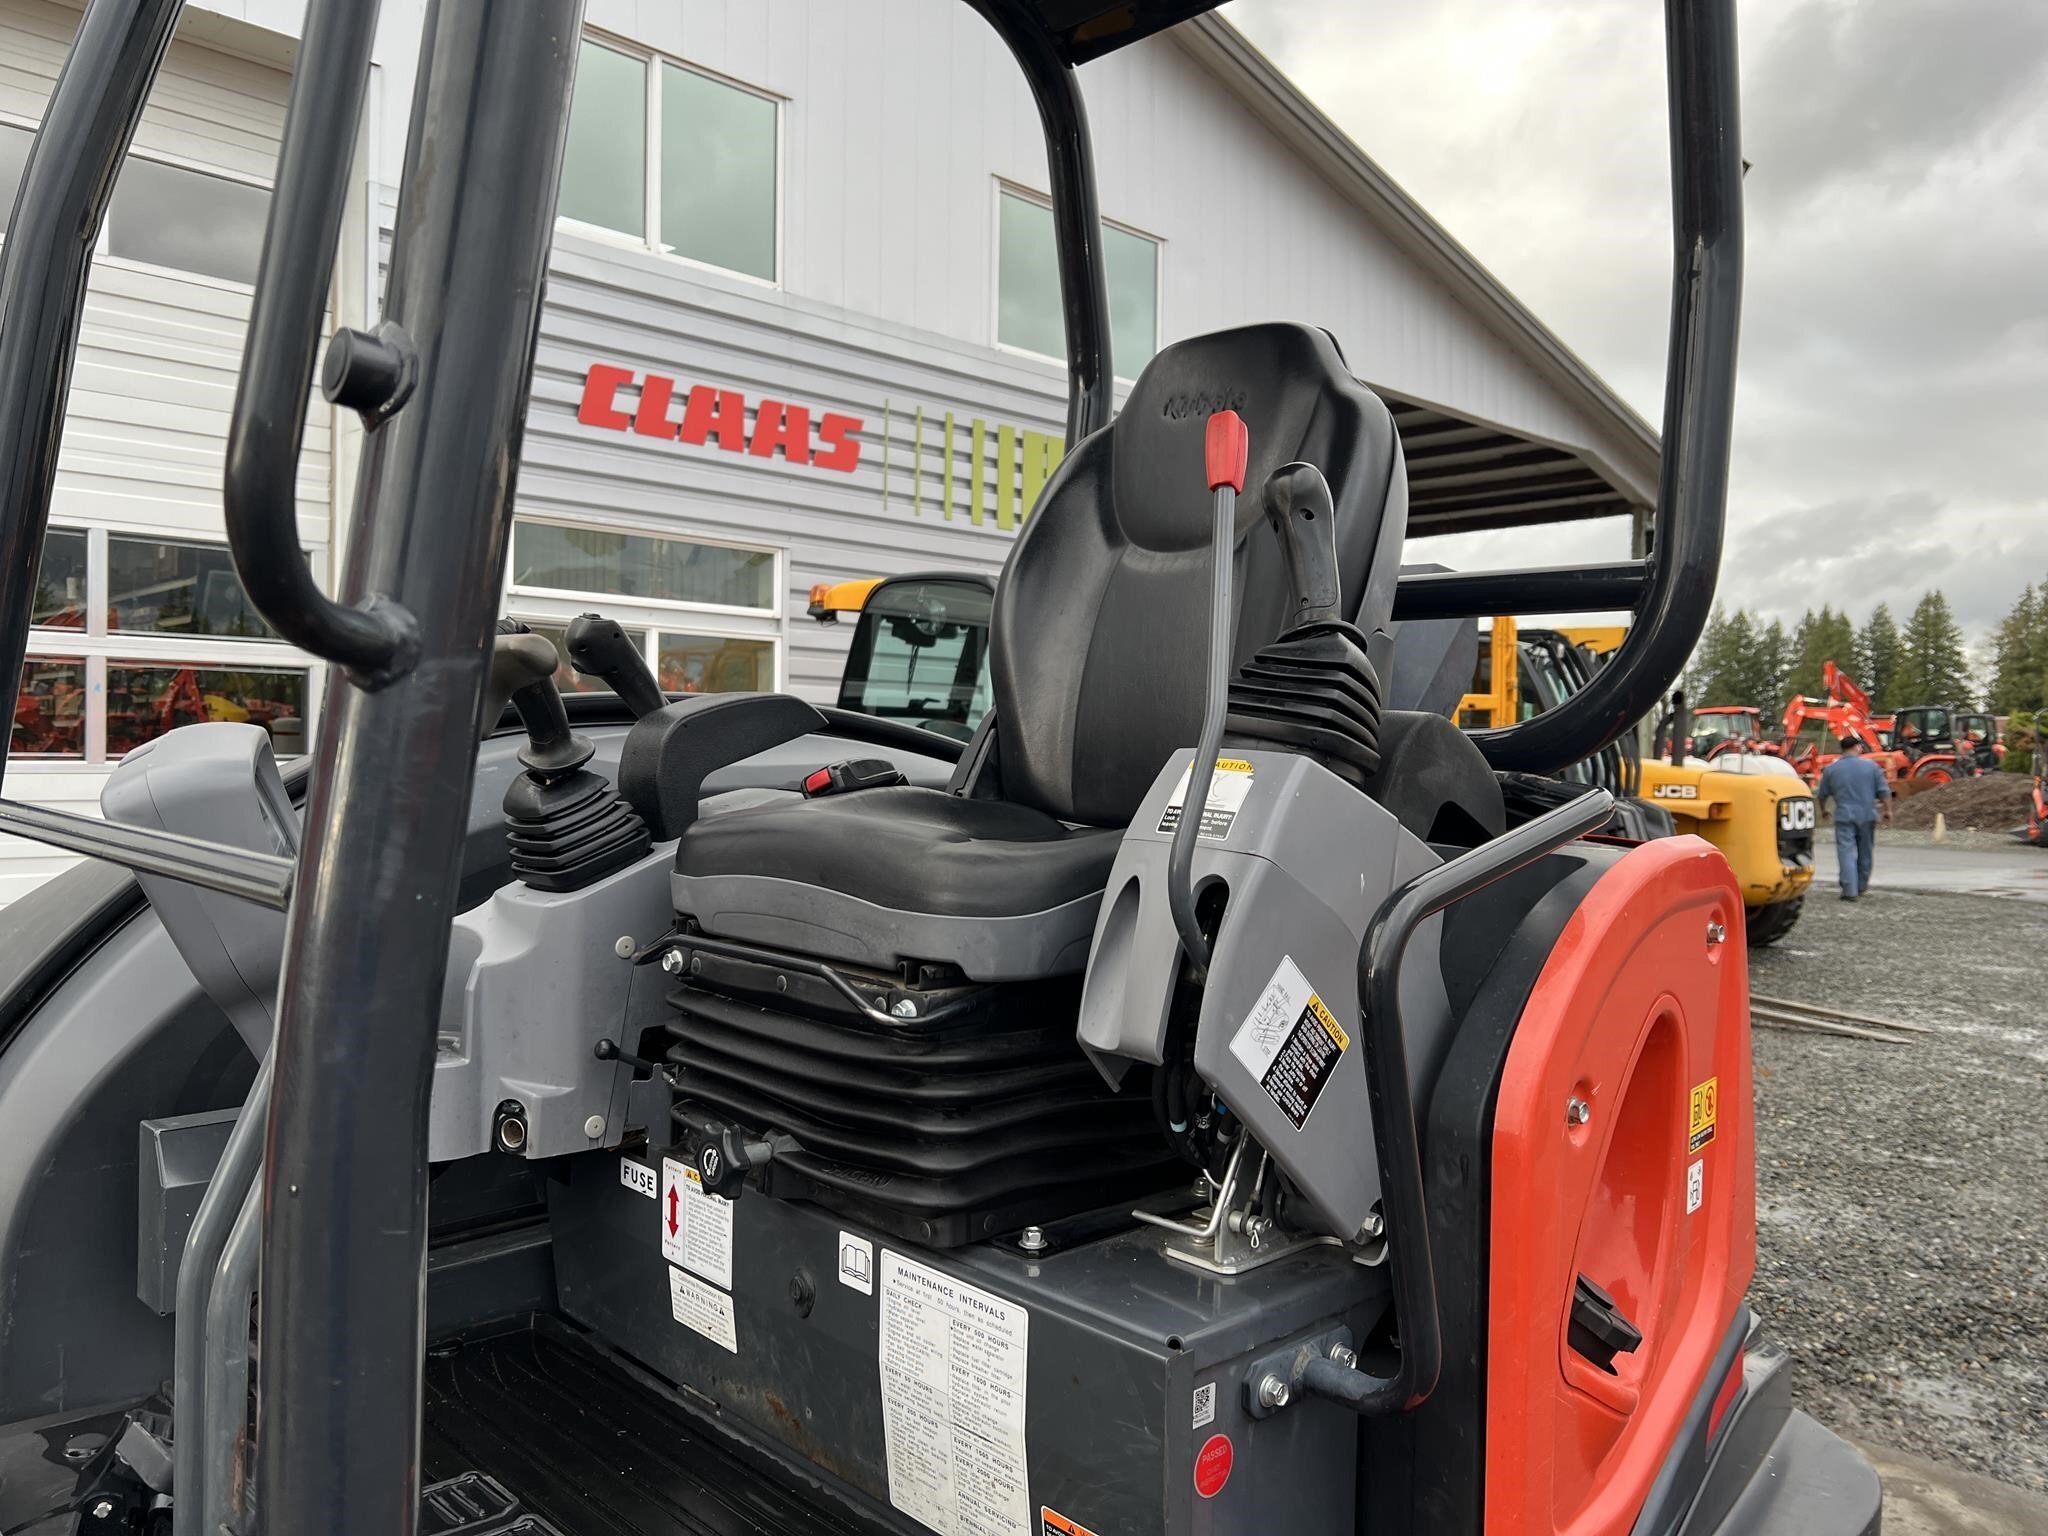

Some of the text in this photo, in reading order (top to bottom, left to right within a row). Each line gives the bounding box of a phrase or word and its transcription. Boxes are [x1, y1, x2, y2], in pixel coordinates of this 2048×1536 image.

[578, 363, 863, 472] CLAAS
[1216, 761, 1253, 770] AUTION
[1654, 785, 1697, 798] JCB
[1781, 801, 1814, 830] JCB
[1319, 1010, 1344, 1043] CAUTION
[623, 1164, 654, 1192] FUSE
[666, 1163, 681, 1174] Pattern
[686, 1288, 718, 1312] WARNING
[886, 1289, 922, 1310] DAILY CHECK
[898, 1267, 1005, 1321] MAINTENANCE INTERVALS
[953, 1319, 971, 1333] EVERY
[988, 1335, 1009, 1350] HOURS
[885, 1365, 901, 1379] EVERY
[914, 1380, 933, 1394] HOURS
[952, 1364, 970, 1379] EVERY
[990, 1383, 1010, 1398] HOURS
[888, 1397, 904, 1411] EVERY
[920, 1414, 938, 1428] HOURS
[954, 1436, 972, 1452] EVERY
[992, 1457, 1013, 1473] HOURS
[1202, 1444, 1228, 1464] PASSED
[955, 1455, 973, 1470] EVERY
[994, 1476, 1015, 1493] HOURS
[958, 1491, 981, 1509] ANNUAL
[984, 1505, 1016, 1529] SERVICING
